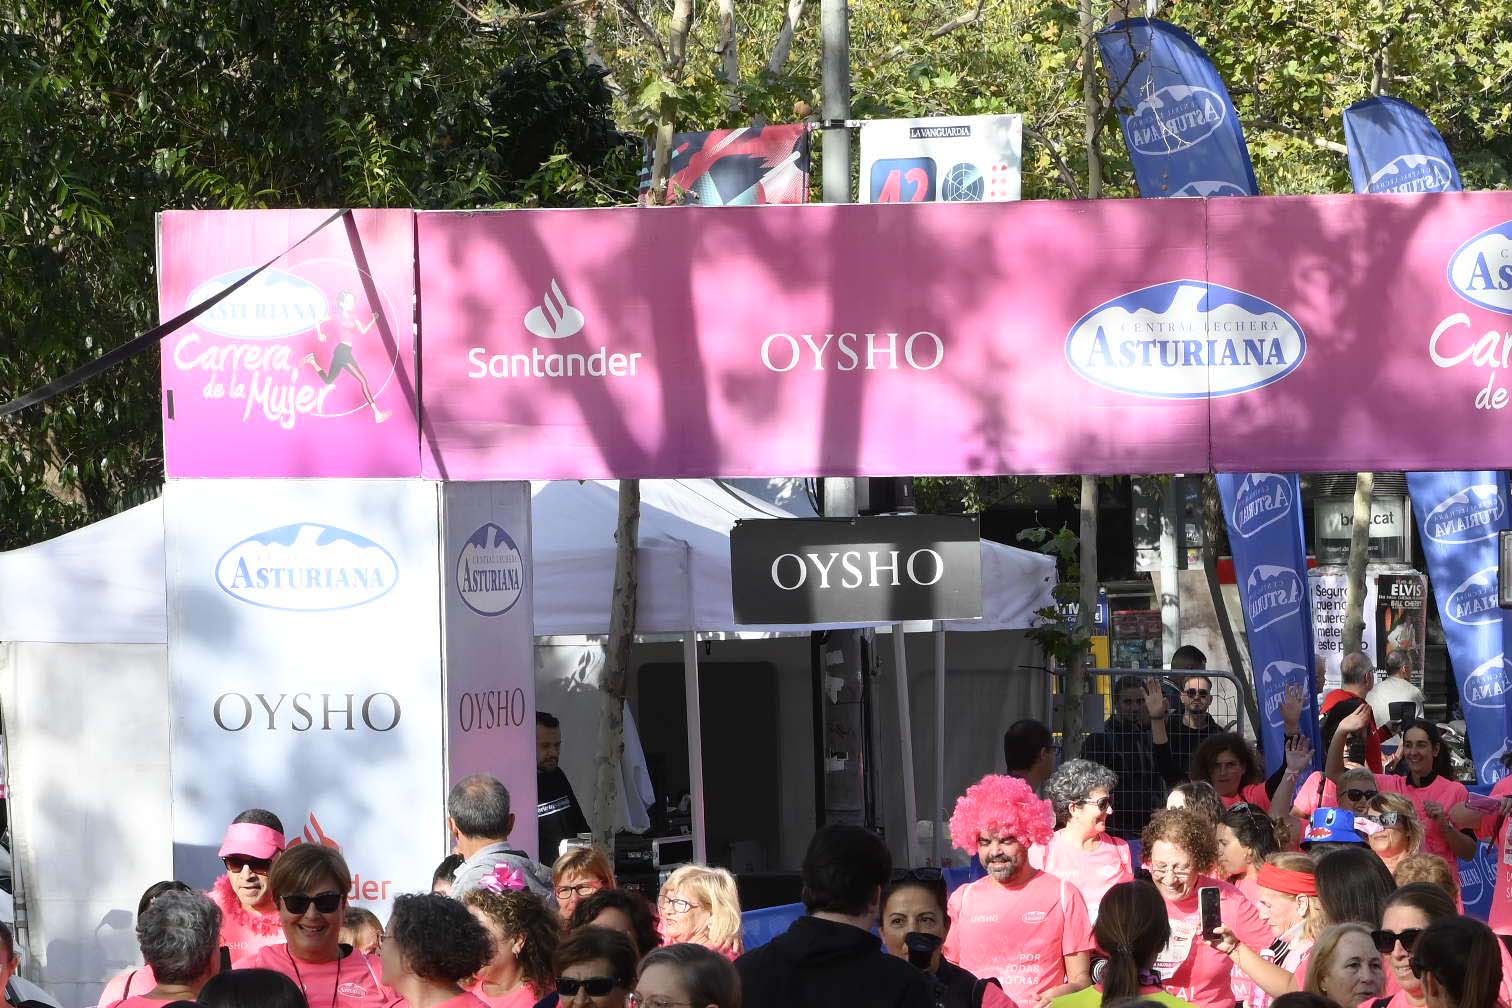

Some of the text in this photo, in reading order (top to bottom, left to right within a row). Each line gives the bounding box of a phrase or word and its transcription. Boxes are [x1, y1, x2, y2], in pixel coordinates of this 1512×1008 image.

[911, 126, 970, 138] LA VANGUARDIA
[1204, 320, 1279, 332] LECHERA
[174, 333, 292, 371] Carrera
[467, 346, 642, 378] Santander
[760, 331, 944, 373] OYSHO
[1087, 325, 1287, 367] ASTURIANA
[203, 367, 336, 430] de la Mujer
[1474, 372, 1509, 409] de
[231, 556, 385, 590] ASTURIANA
[462, 562, 520, 594] ASTURIANA
[771, 548, 944, 591] OYSHO
[1316, 601, 1333, 612] que
[1391, 584, 1422, 596] ELVIS
[1318, 641, 1336, 651] este
[213, 692, 402, 732] OYSHO
[460, 687, 526, 734] OYSHO
[1019, 953, 1041, 962] POR
